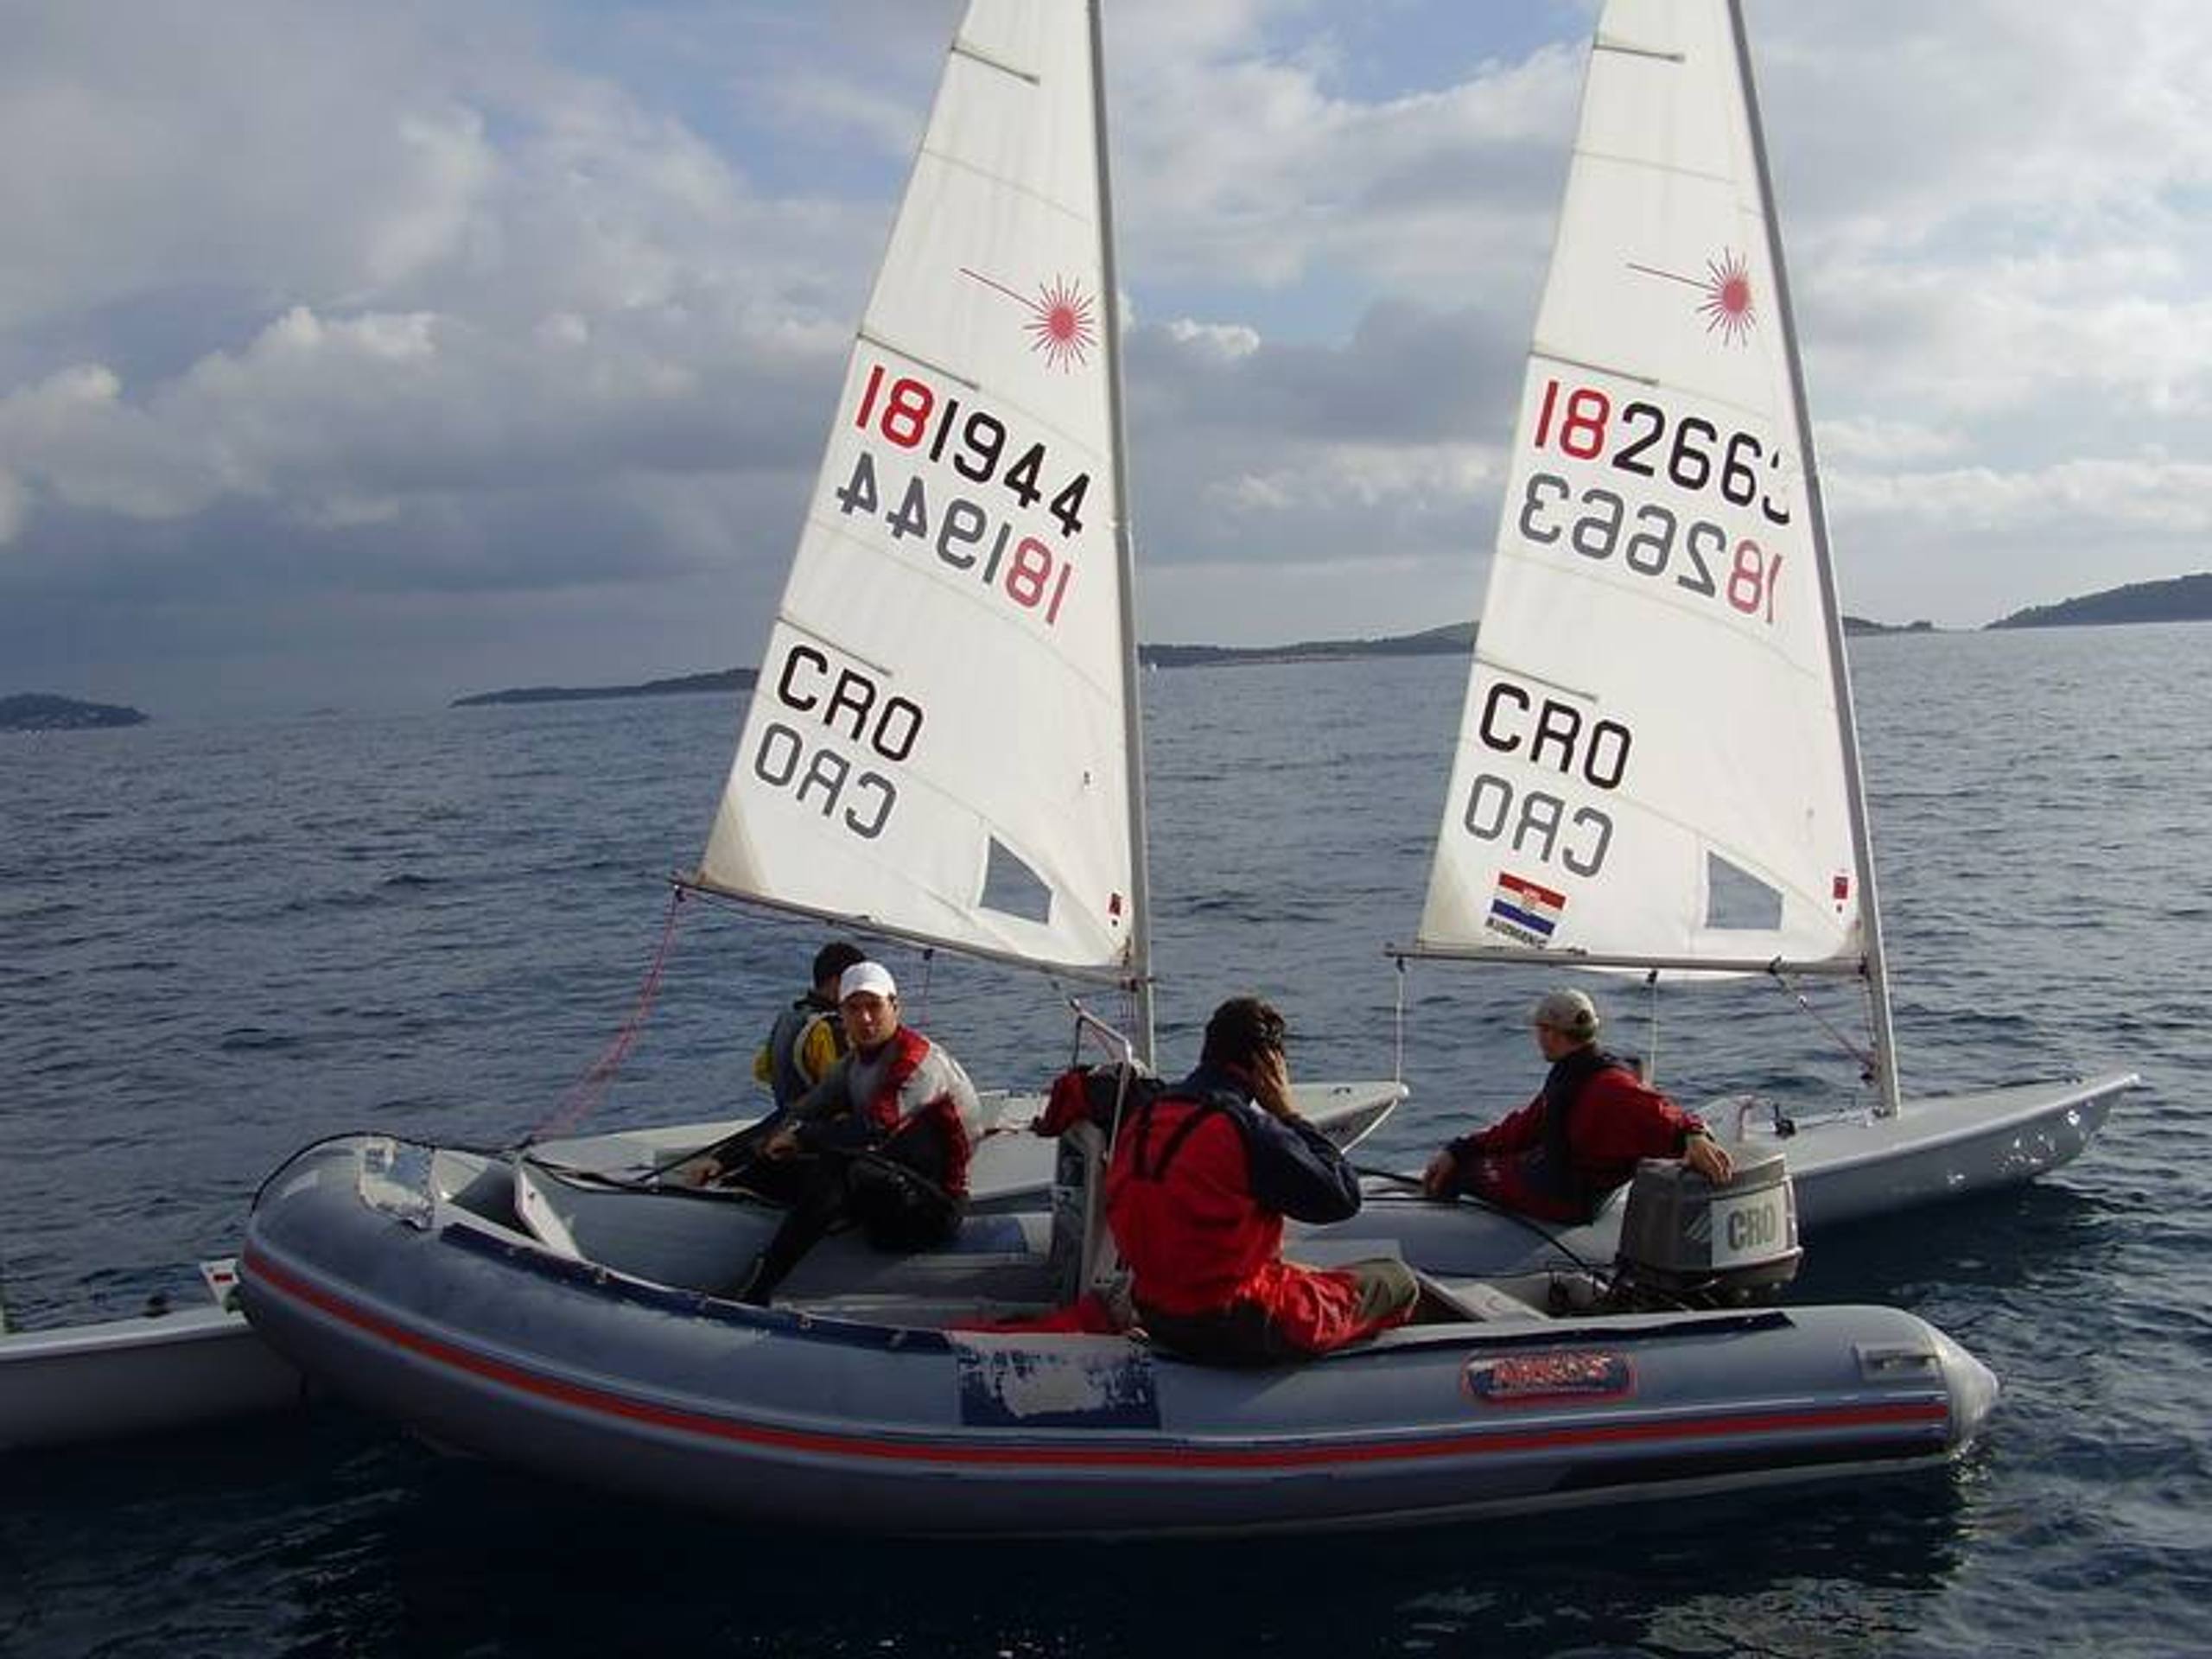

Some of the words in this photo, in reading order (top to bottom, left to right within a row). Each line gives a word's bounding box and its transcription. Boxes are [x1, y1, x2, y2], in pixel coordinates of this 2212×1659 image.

[855, 365, 1090, 537] 181944
[777, 645, 924, 762] CRO
[1478, 683, 1633, 790] CRO
[1728, 1204, 1777, 1251] CRO
